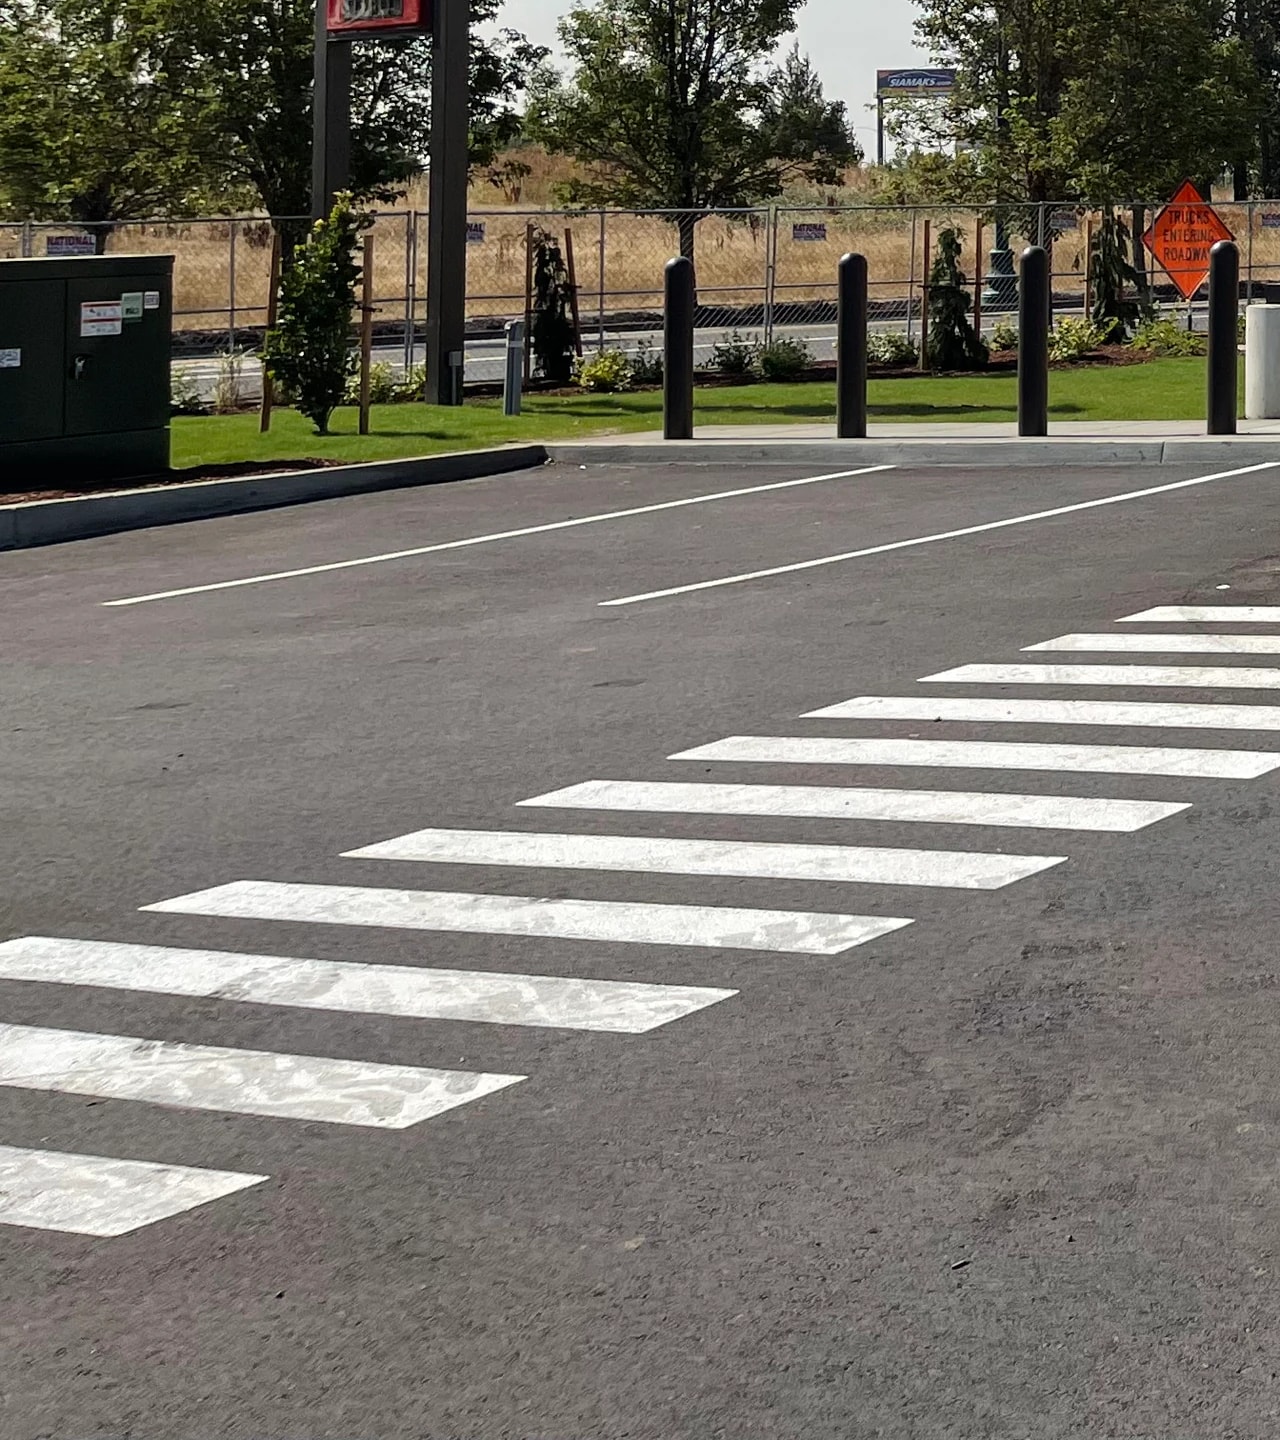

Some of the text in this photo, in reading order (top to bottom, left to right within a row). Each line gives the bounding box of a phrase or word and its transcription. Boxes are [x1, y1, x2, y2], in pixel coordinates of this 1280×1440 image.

[889, 77, 937, 88] SIAMAKS
[1168, 210, 1209, 225] TRUCKS
[1163, 228, 1214, 243] ENTERING
[1163, 247, 1211, 262] ROADWA
